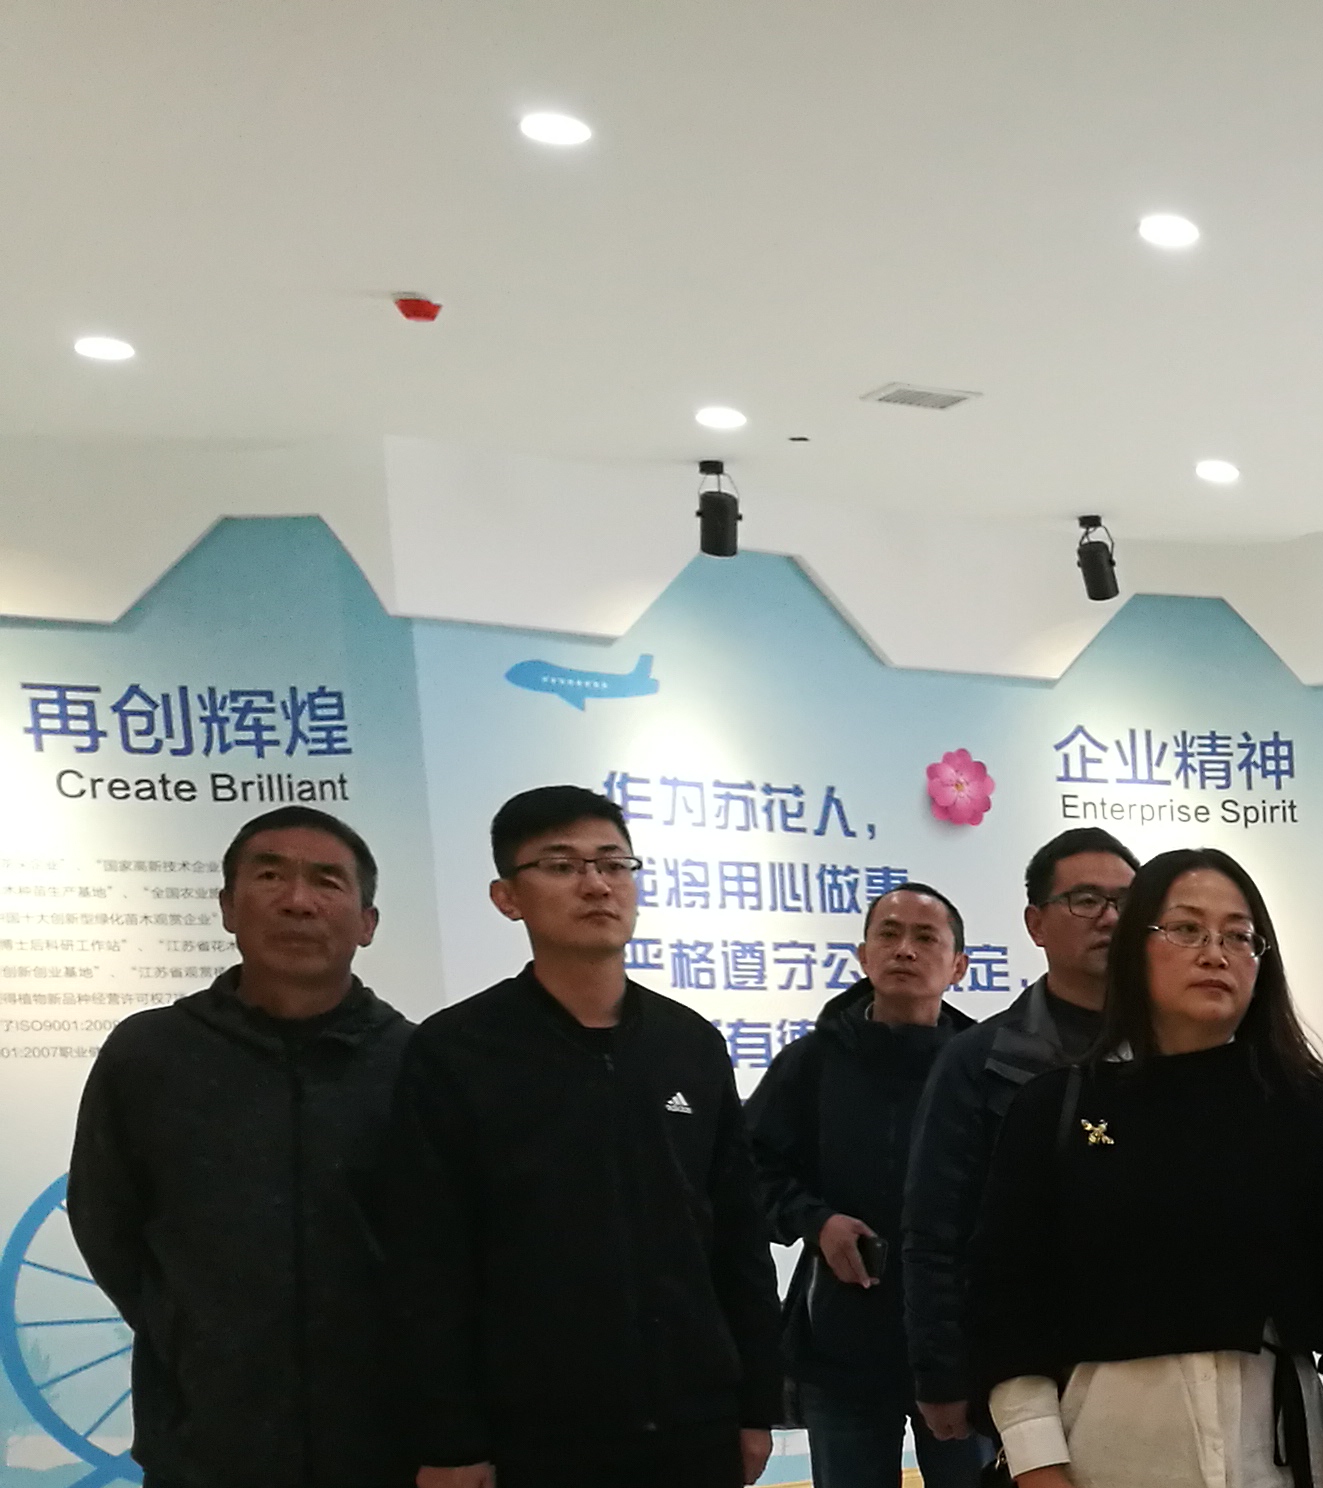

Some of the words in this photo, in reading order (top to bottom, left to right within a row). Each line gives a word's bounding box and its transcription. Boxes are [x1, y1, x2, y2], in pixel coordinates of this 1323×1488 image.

[20, 682, 353, 759] 再创辉煌
[1053, 725, 1295, 790] 企业精神
[56, 769, 198, 801] Create
[210, 772, 350, 802] Brilliant
[1062, 794, 1211, 826] Enterprise
[1221, 799, 1299, 828] Spirit
